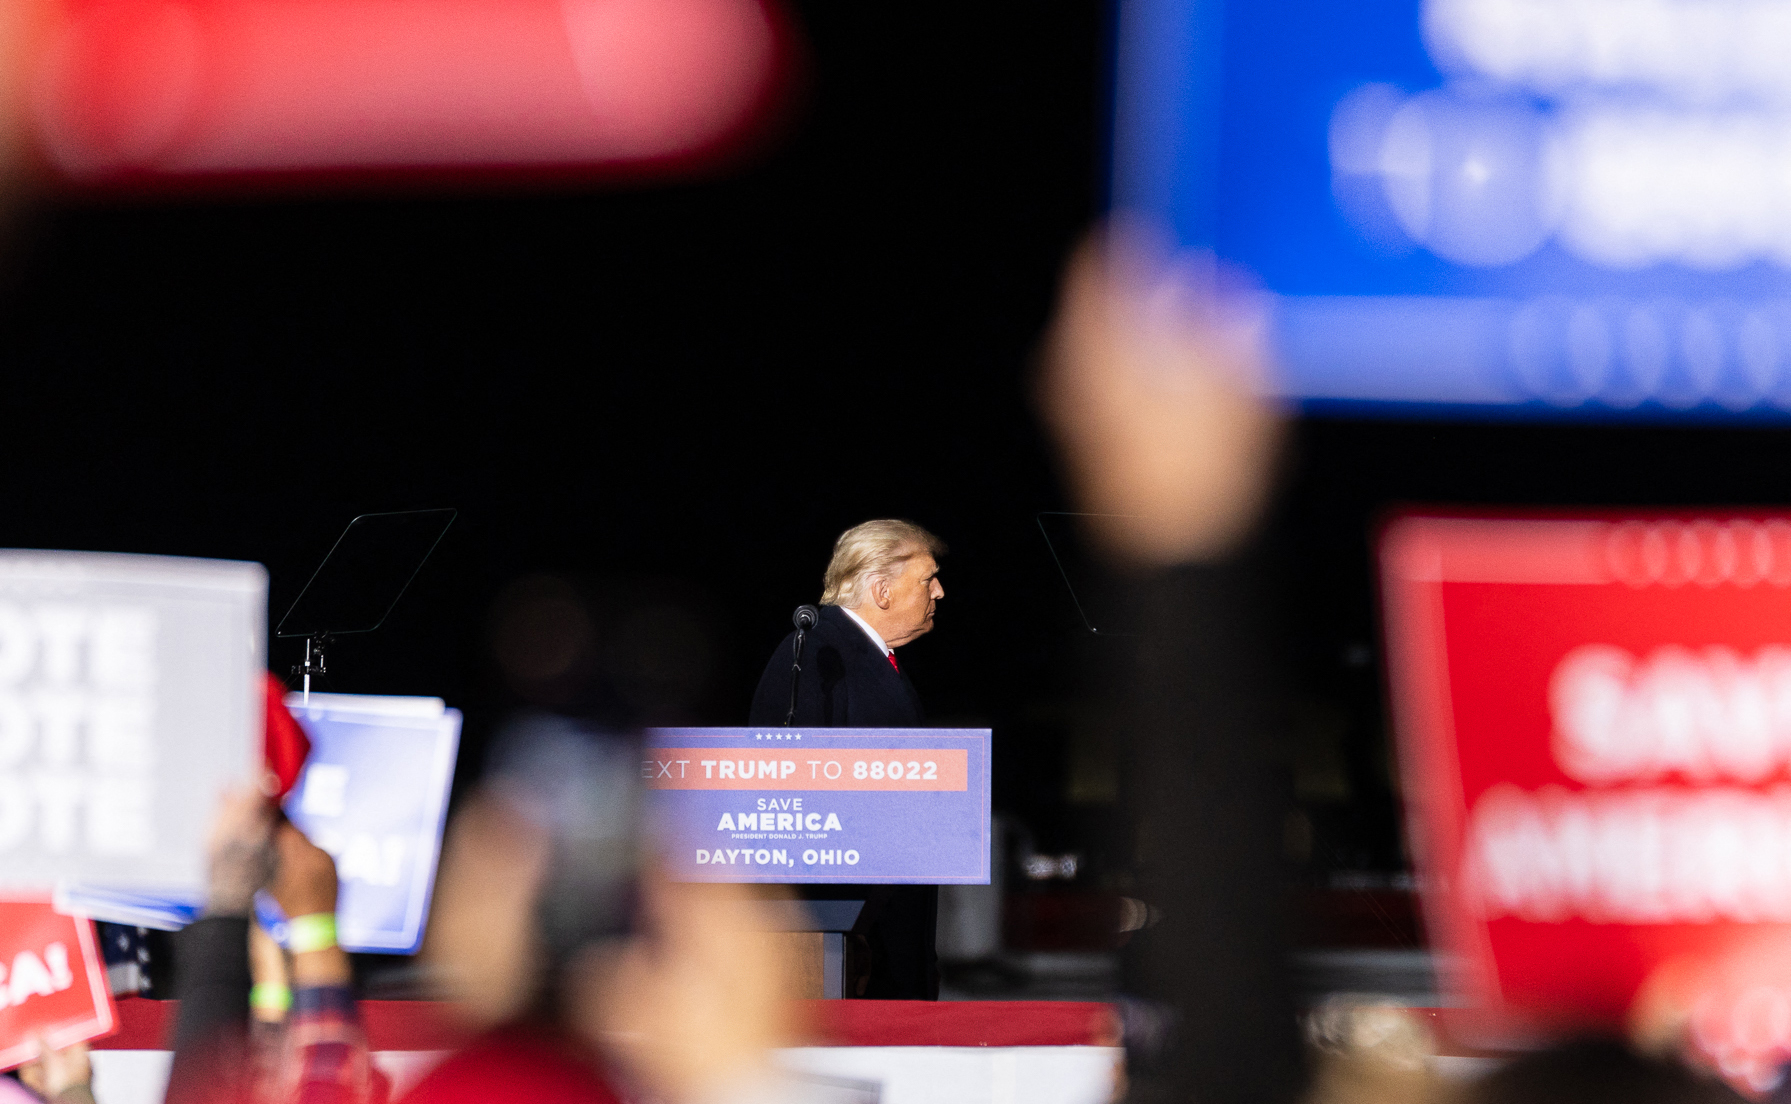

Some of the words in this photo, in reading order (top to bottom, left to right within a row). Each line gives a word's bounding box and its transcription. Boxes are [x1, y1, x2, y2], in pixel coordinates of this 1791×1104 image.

[640, 760, 690, 779] EXT
[701, 760, 796, 779] TRUMP
[806, 760, 842, 780] TO
[853, 760, 938, 780] 88022
[757, 798, 803, 811] SAVE
[717, 812, 843, 831] AMERICA
[696, 849, 795, 868] DAYTON,
[802, 849, 860, 866] OHIO
